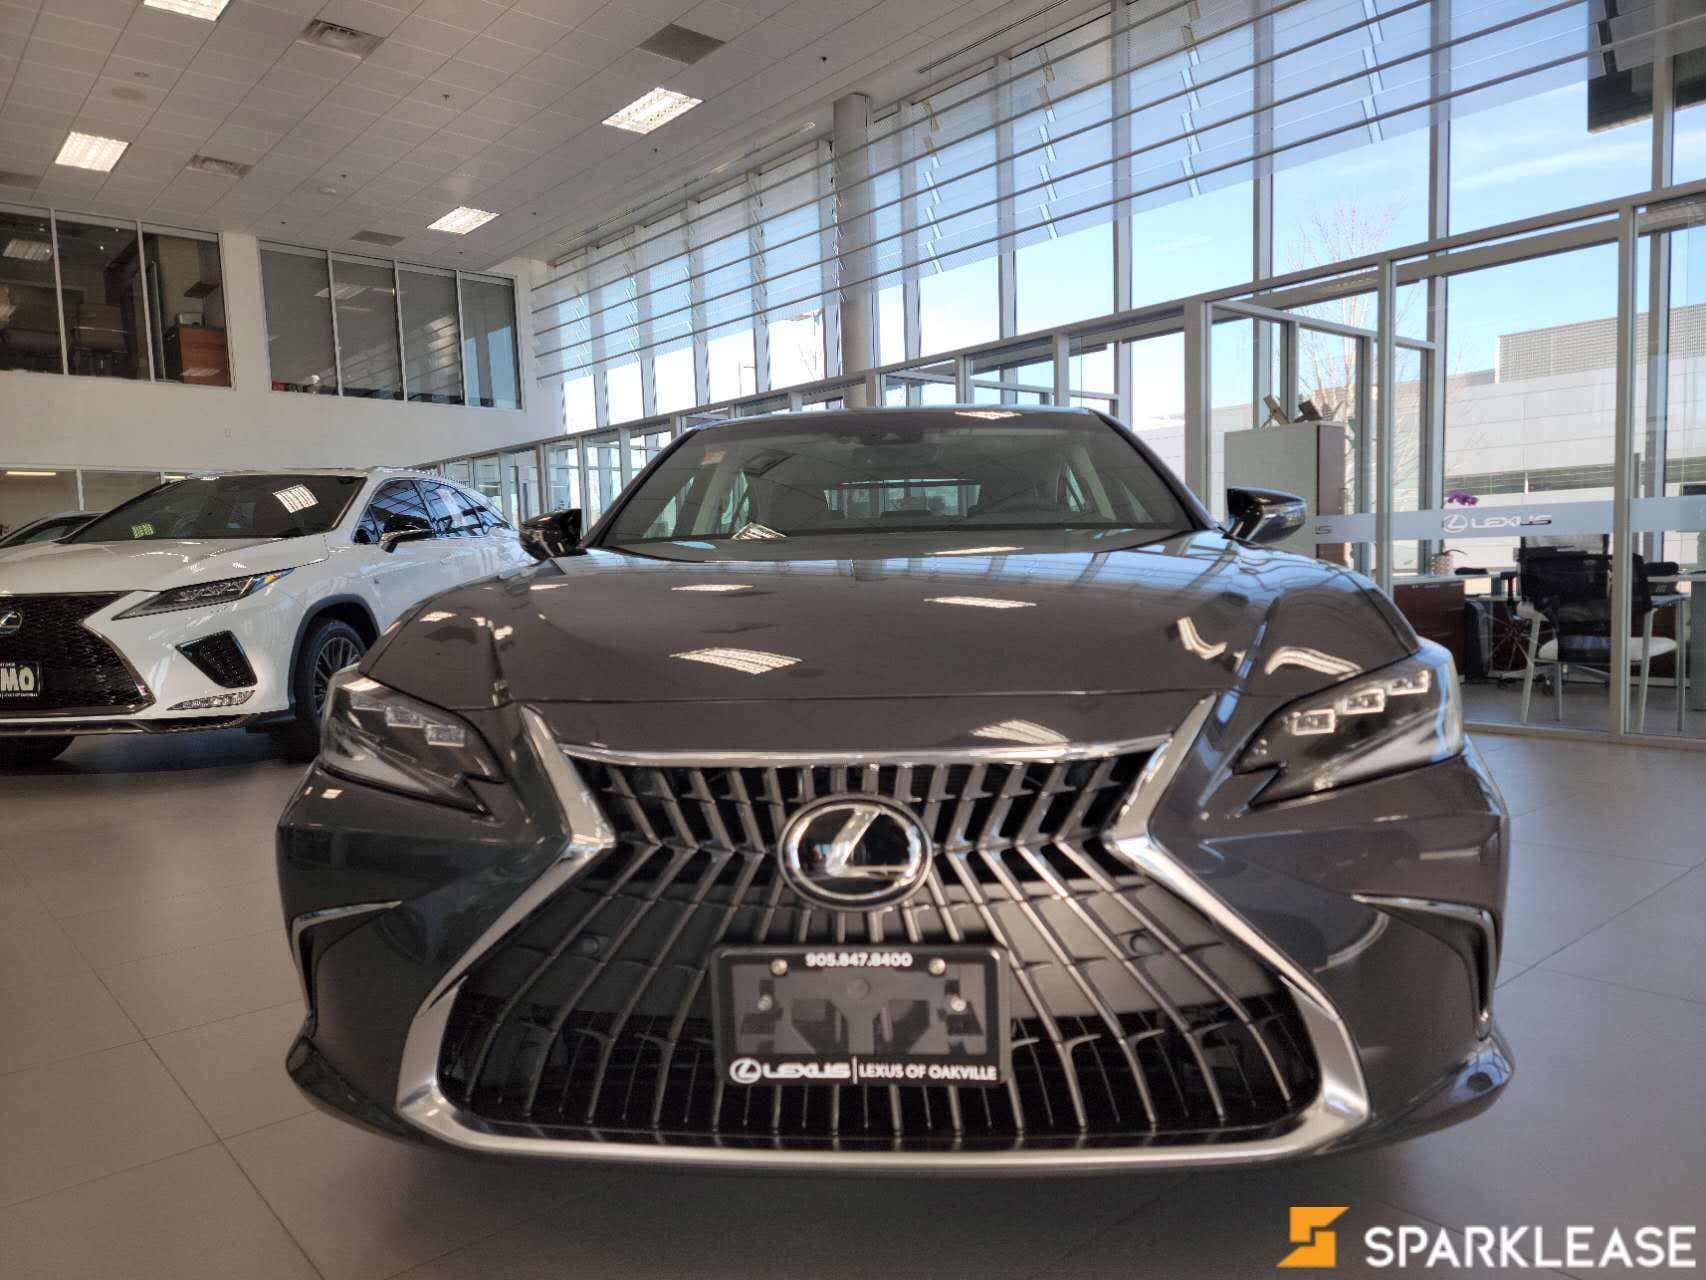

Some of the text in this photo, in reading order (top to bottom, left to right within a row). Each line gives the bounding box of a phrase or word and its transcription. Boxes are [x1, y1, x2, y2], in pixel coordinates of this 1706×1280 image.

[1471, 514, 1552, 528] LEXUS
[762, 1062, 851, 1079] LEXUS
[859, 1063, 997, 1081] LEXUS OF OAKVILLE
